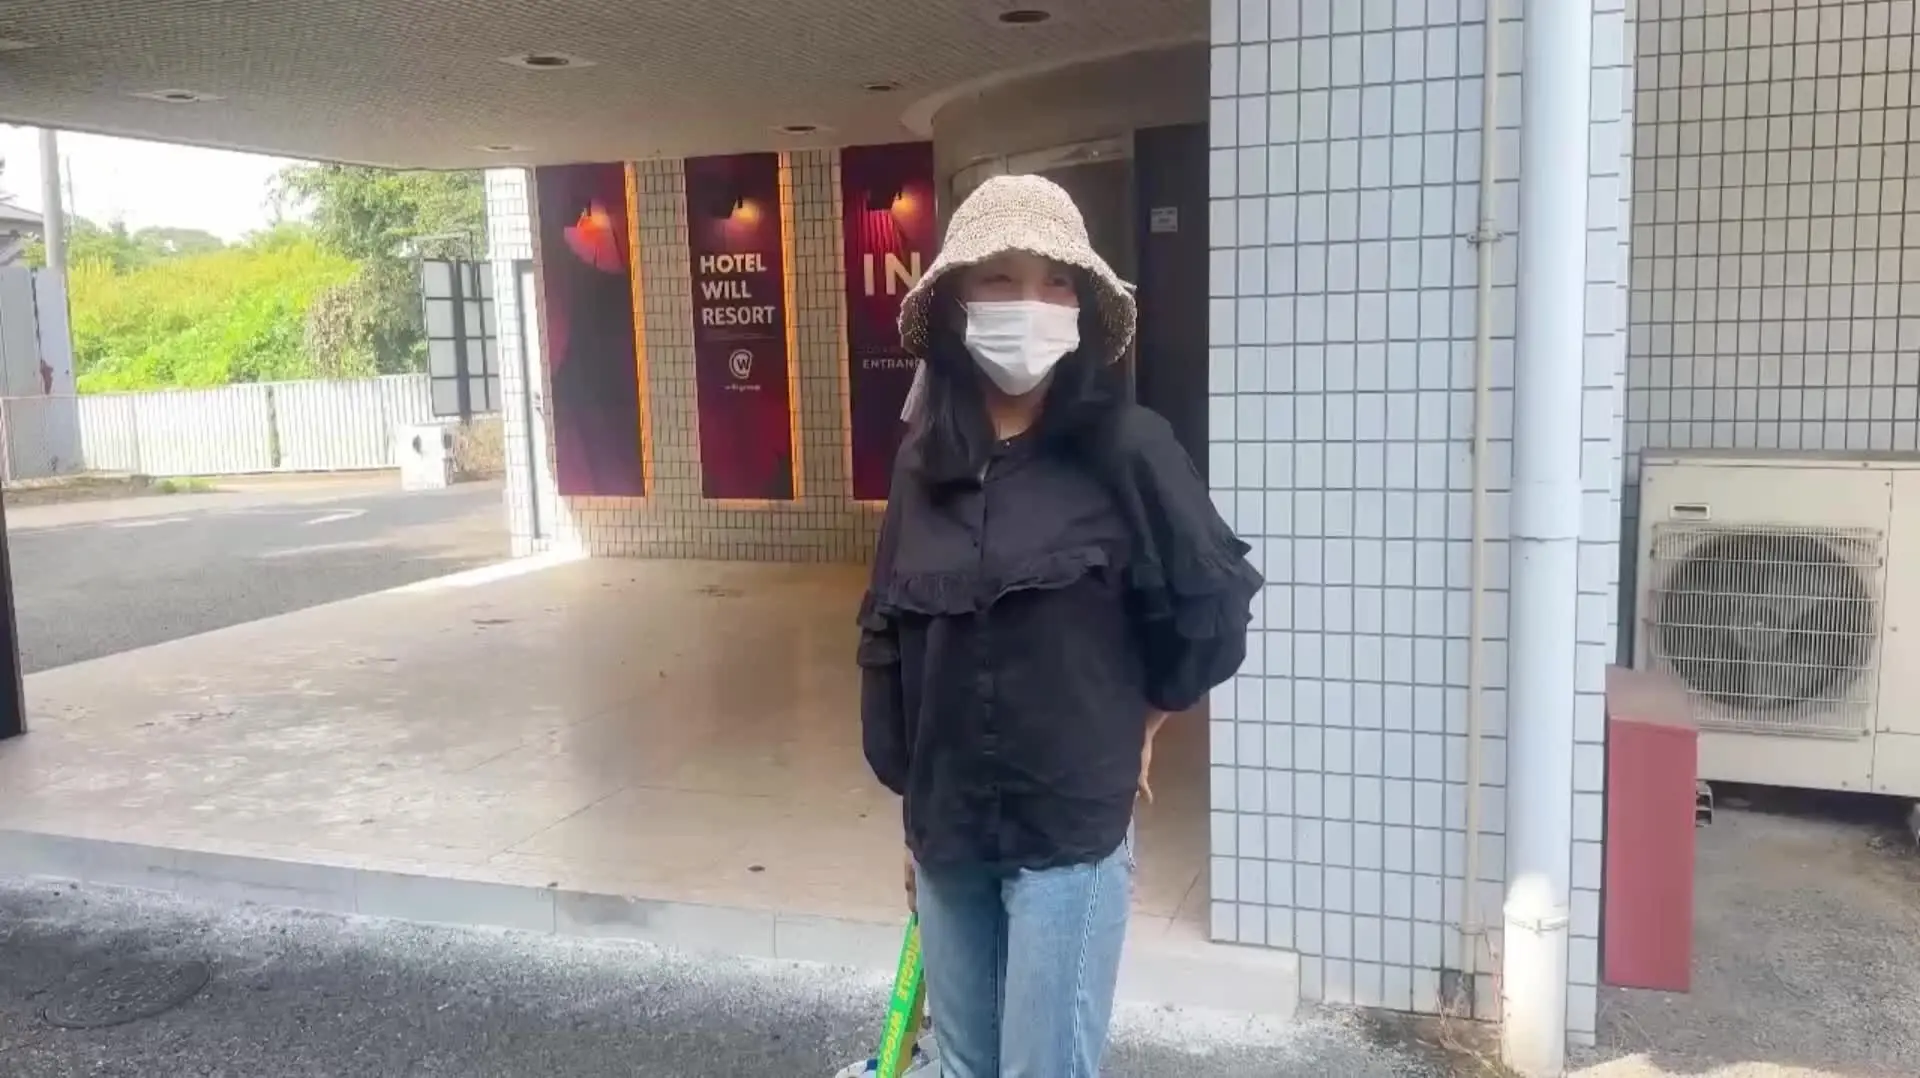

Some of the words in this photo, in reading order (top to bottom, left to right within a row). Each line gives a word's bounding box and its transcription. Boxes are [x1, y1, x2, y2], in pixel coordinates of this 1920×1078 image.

[700, 253, 767, 274] HOTEL
[864, 251, 920, 296] IN
[701, 280, 752, 300] WILL
[702, 306, 776, 325] RESORT
